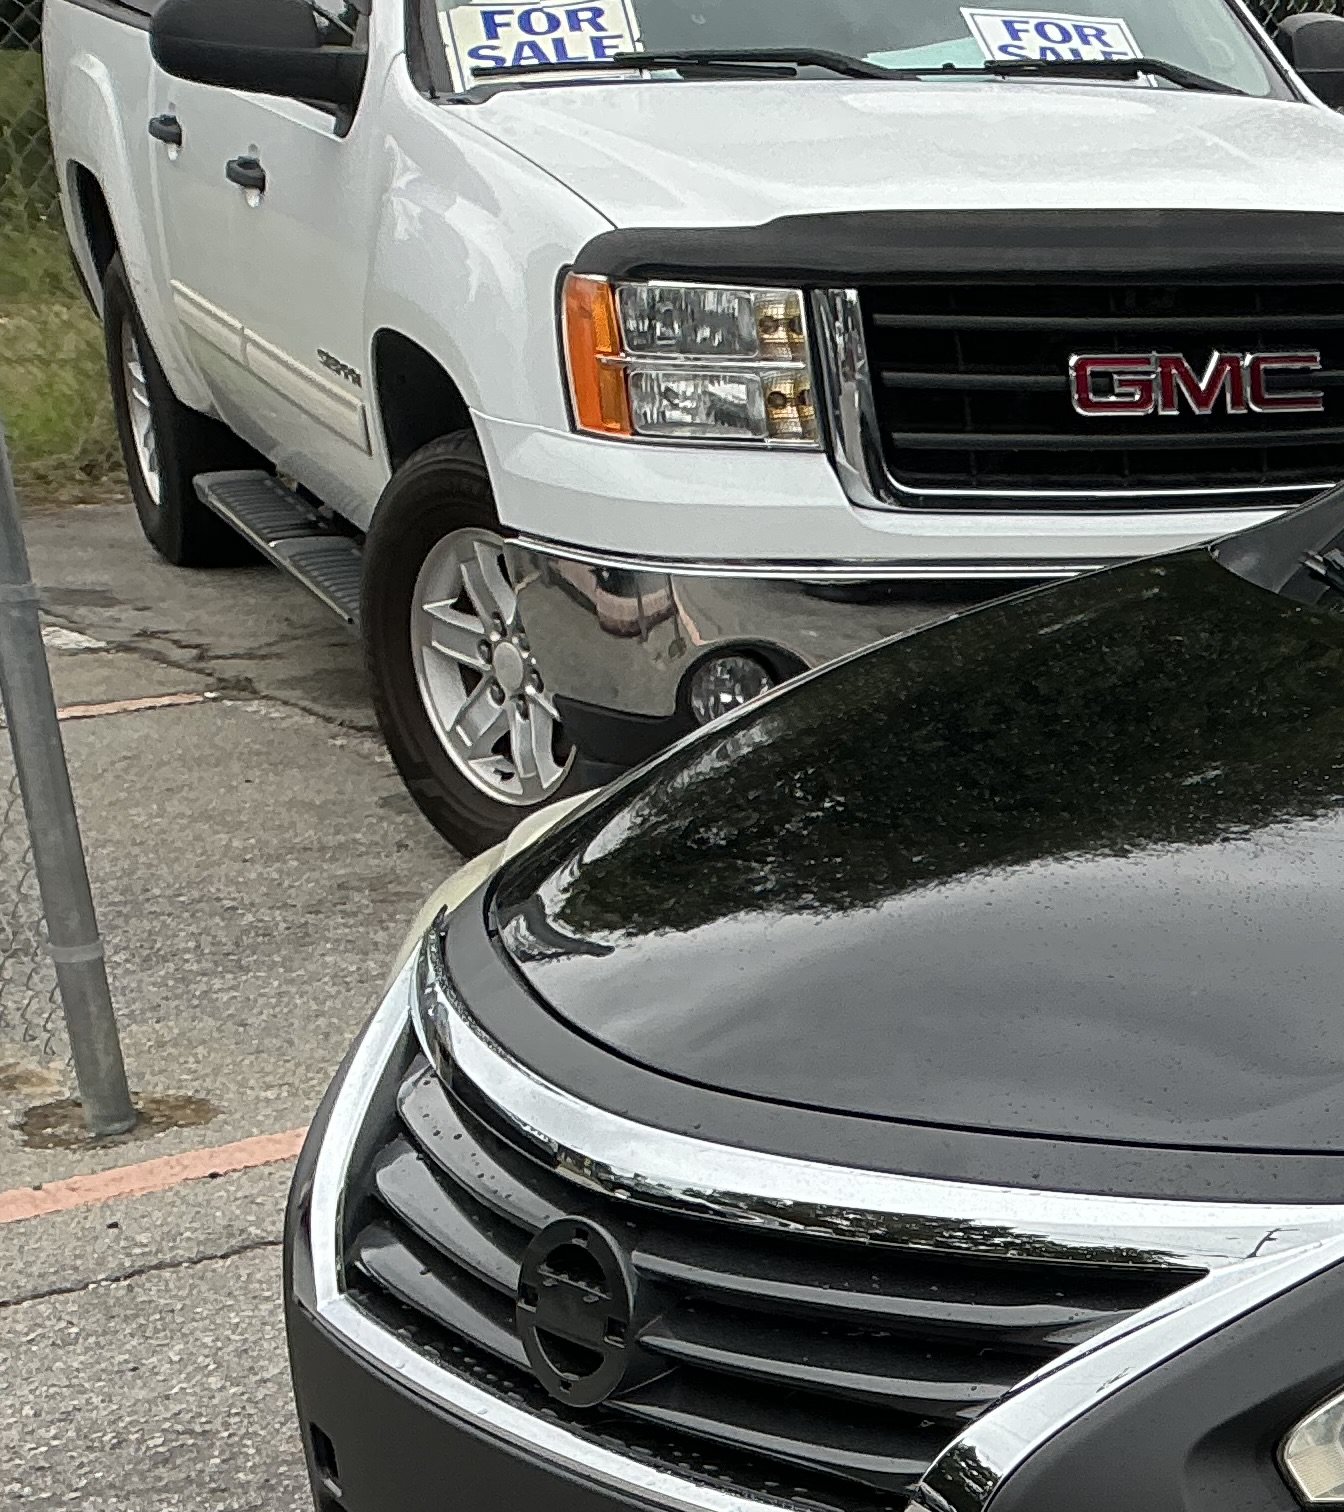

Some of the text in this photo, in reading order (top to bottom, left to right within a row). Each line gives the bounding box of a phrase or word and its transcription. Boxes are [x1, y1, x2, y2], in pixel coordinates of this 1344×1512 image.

[480, 6, 608, 40] FOR
[1001, 19, 1113, 47] FOR
[467, 34, 624, 67] SALE
[1068, 350, 1325, 416] GMC
